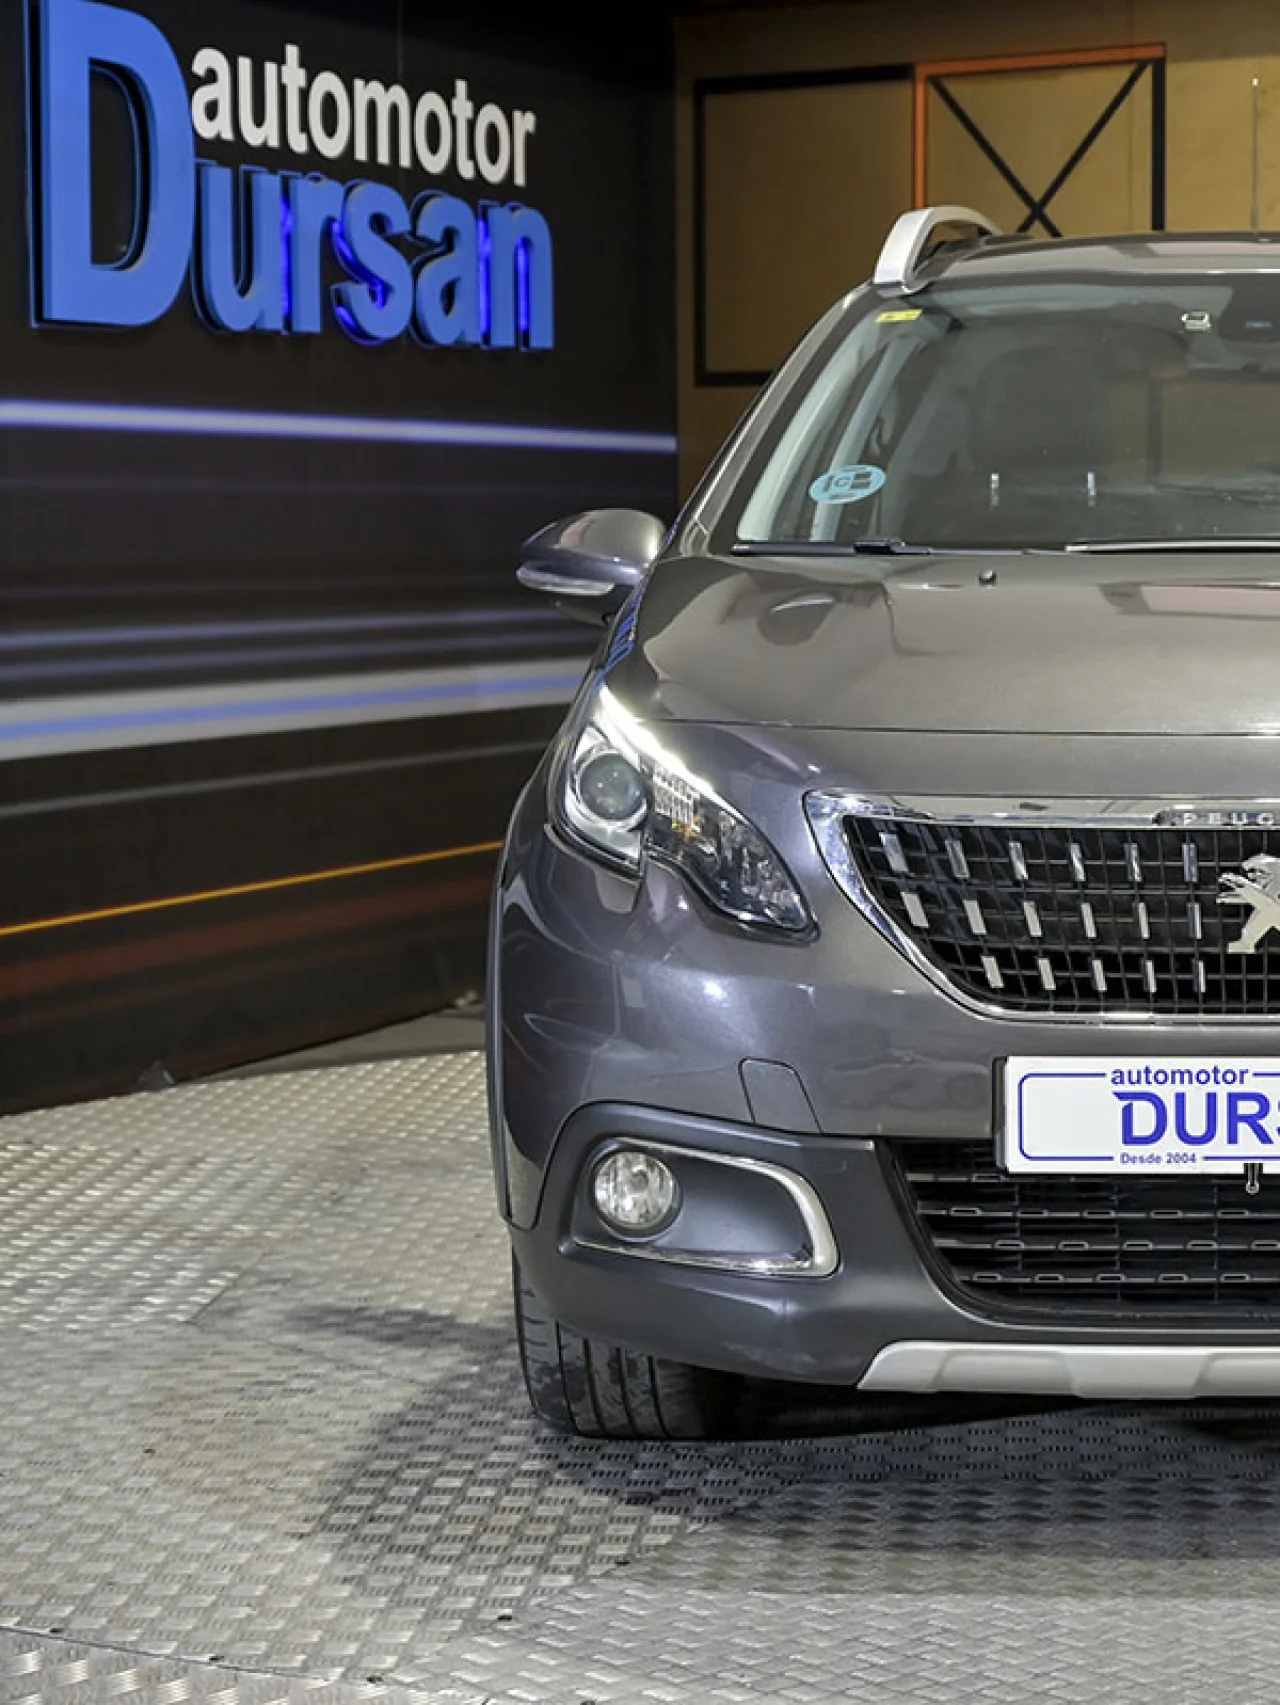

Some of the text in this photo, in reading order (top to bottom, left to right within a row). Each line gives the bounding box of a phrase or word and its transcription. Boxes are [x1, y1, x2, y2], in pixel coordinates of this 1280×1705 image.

[191, 44, 536, 187] automotor
[24, 0, 554, 351] Dursan
[1110, 1065, 1249, 1085] automotor
[1120, 1152, 1197, 1164] Desde 2004
